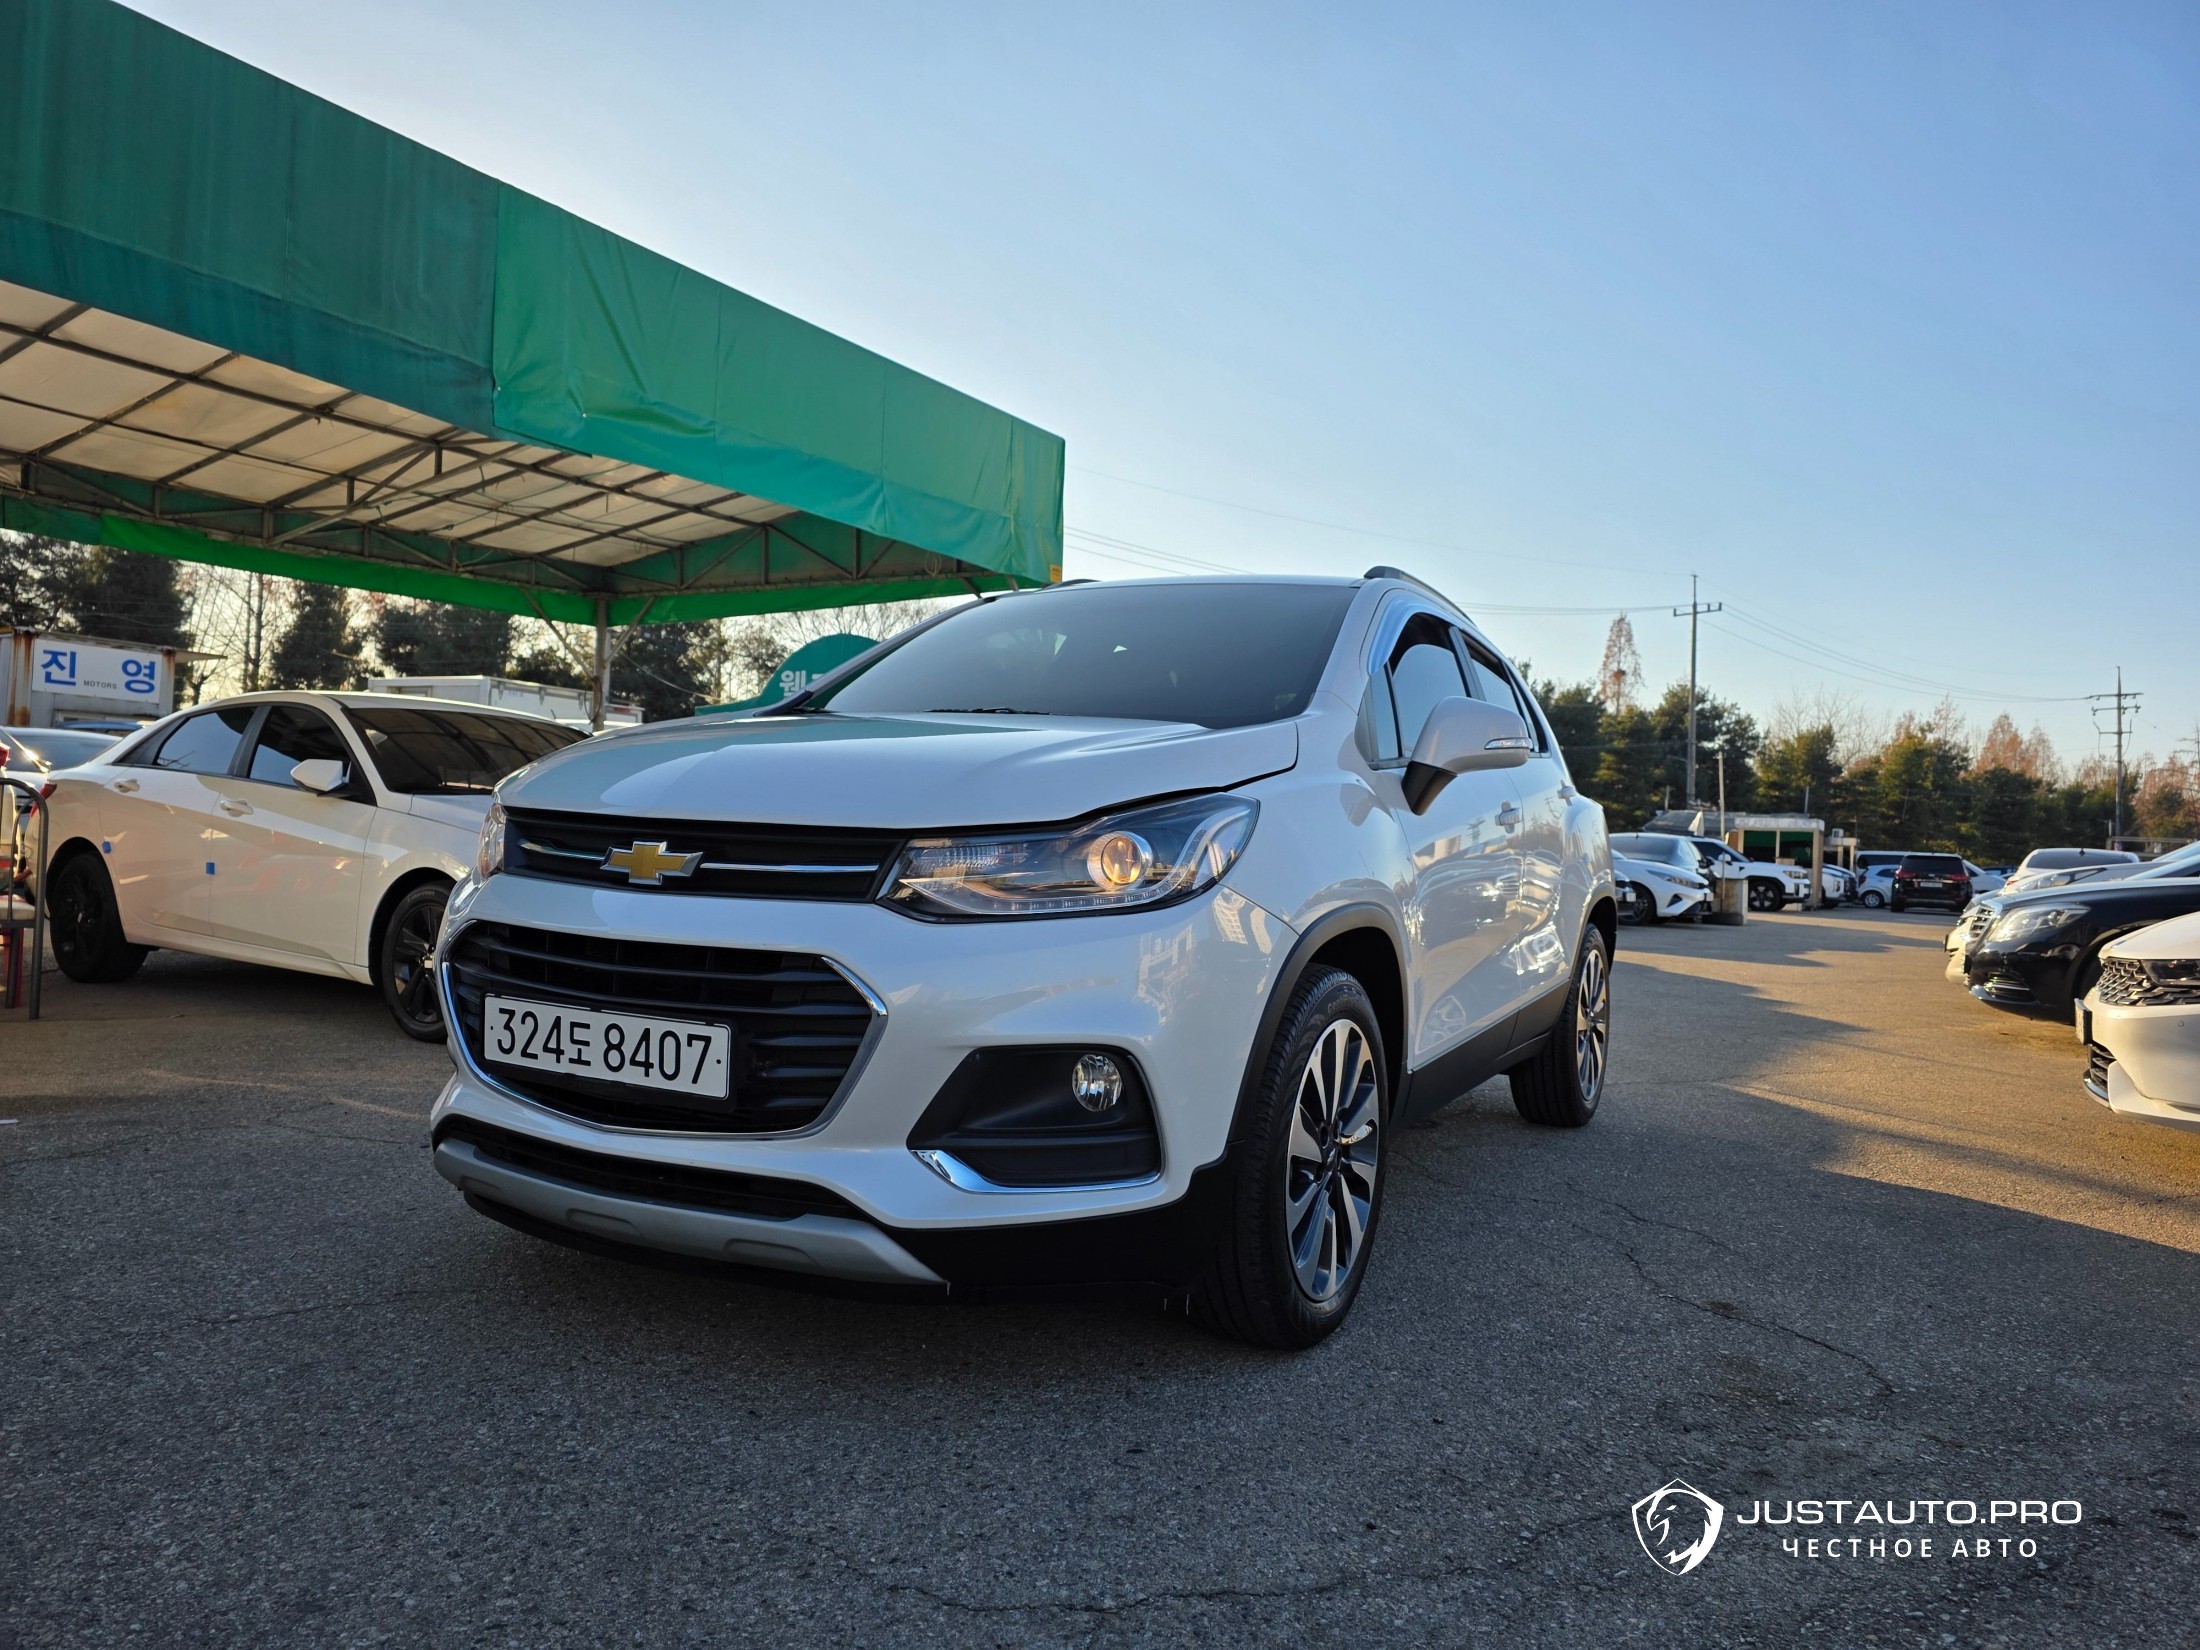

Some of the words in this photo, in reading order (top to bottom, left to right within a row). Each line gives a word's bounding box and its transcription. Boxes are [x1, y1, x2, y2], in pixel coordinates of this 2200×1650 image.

[40, 649, 77, 687] 진
[121, 659, 156, 694] 영
[83, 680, 117, 690] MOTORS
[603, 1022, 712, 1084] 8407
